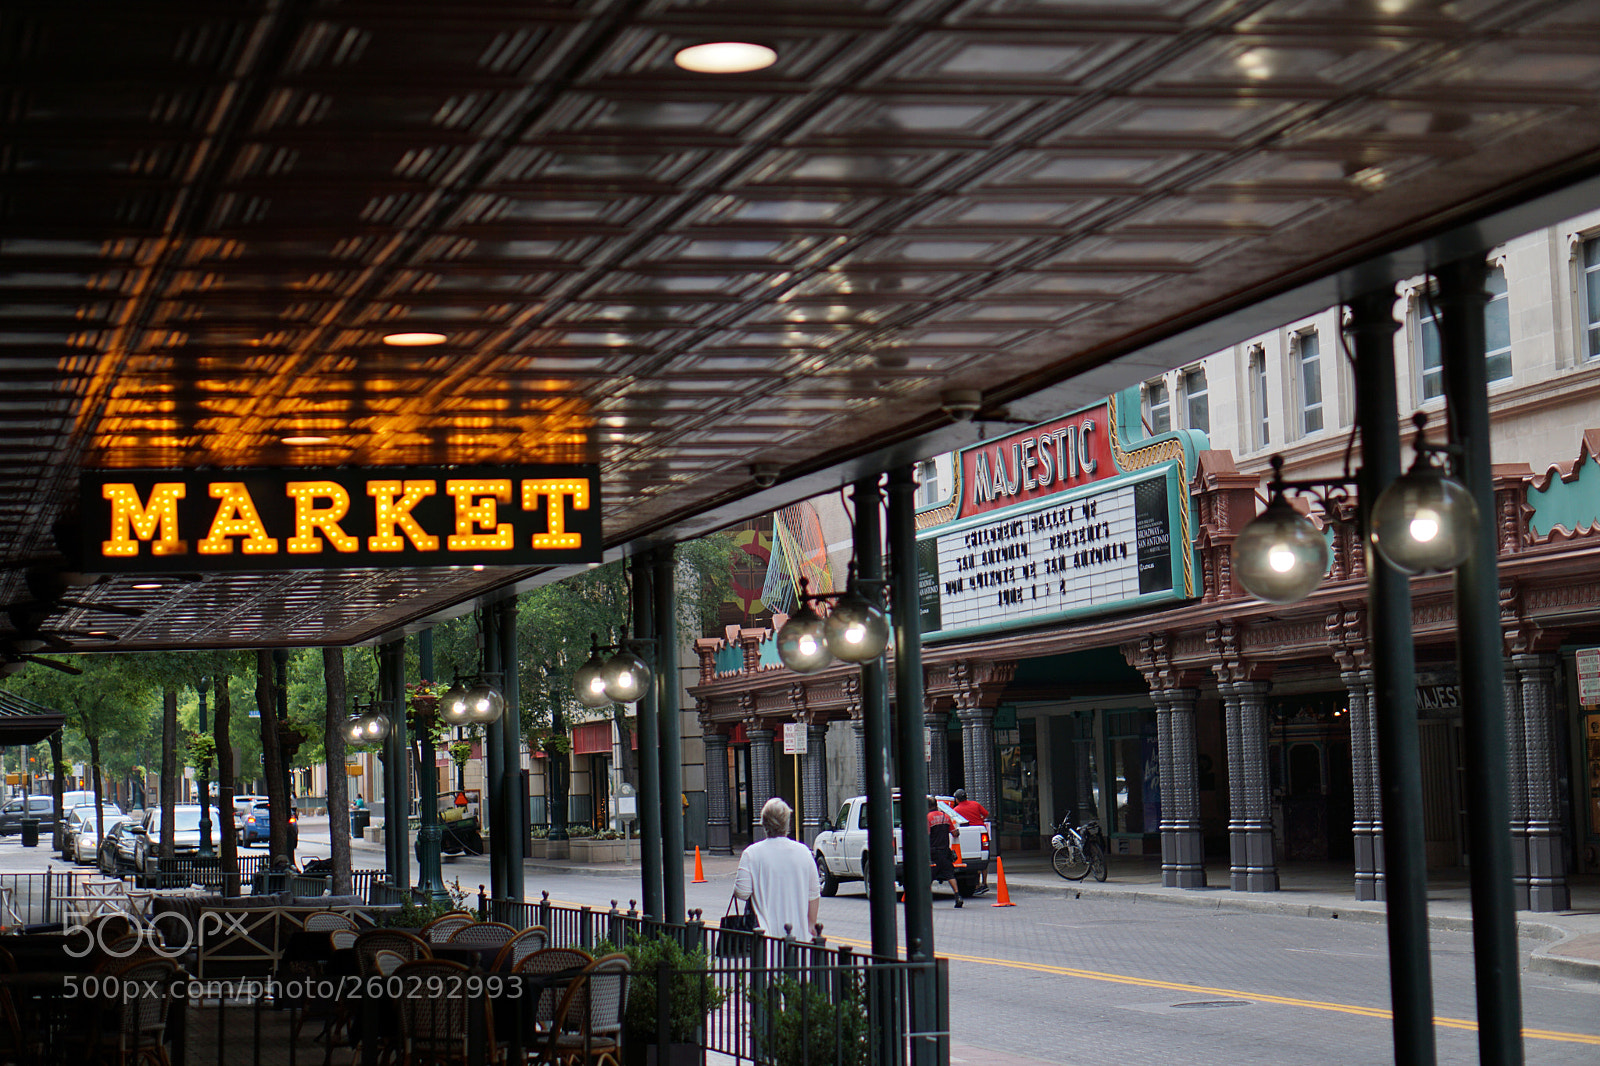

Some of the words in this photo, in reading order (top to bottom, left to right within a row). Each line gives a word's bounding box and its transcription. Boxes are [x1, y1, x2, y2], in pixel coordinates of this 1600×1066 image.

[974, 419, 1096, 505] MAJESTIC
[102, 477, 590, 557] MARKET
[1031, 505, 1073, 533] BALLET
[1082, 499, 1097, 521] OF
[1147, 533, 1169, 547] ANTONIO
[945, 576, 963, 596] DON
[969, 565, 1015, 591] QUIXOTE
[1044, 553, 1066, 574] SAN
[1073, 541, 1128, 569] ANTONIO
[956, 553, 975, 572] SAN
[981, 541, 1028, 566] ANTONIO
[1049, 521, 1109, 550] PRESENTS
[998, 585, 1024, 607] JUNE
[1032, 583, 1037, 600] 1
[1060, 577, 1066, 596] 2
